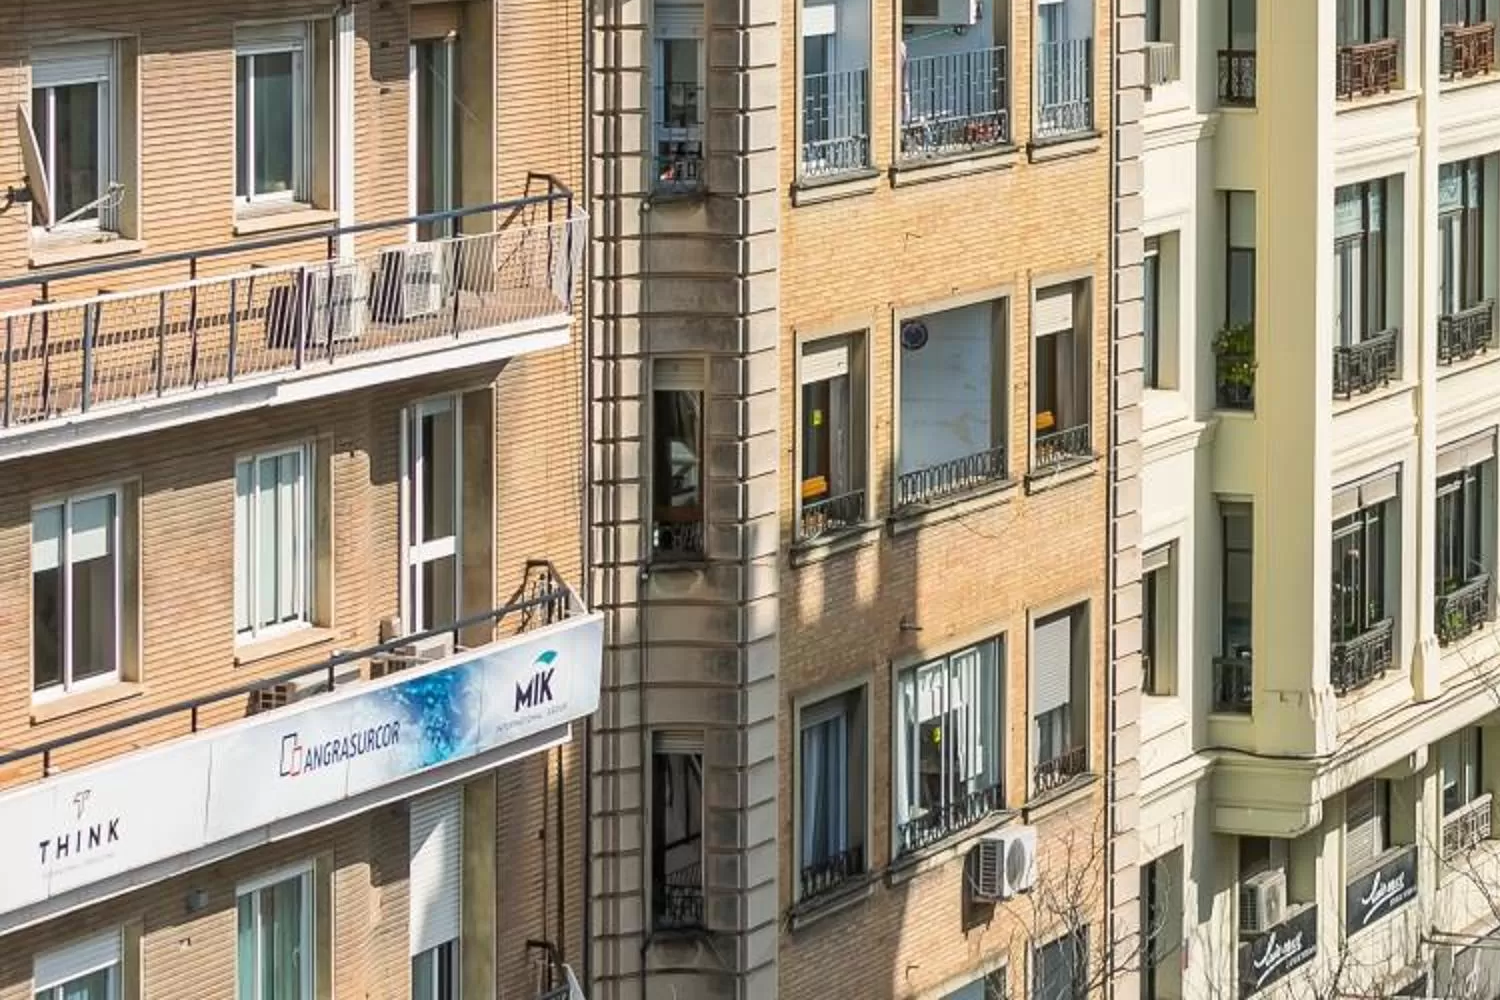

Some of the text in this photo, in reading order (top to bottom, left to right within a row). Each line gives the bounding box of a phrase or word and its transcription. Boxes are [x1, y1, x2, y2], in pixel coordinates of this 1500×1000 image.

[514, 668, 555, 713] MIK
[304, 720, 401, 774] ANGRASURCOR
[39, 818, 120, 864] THINK
